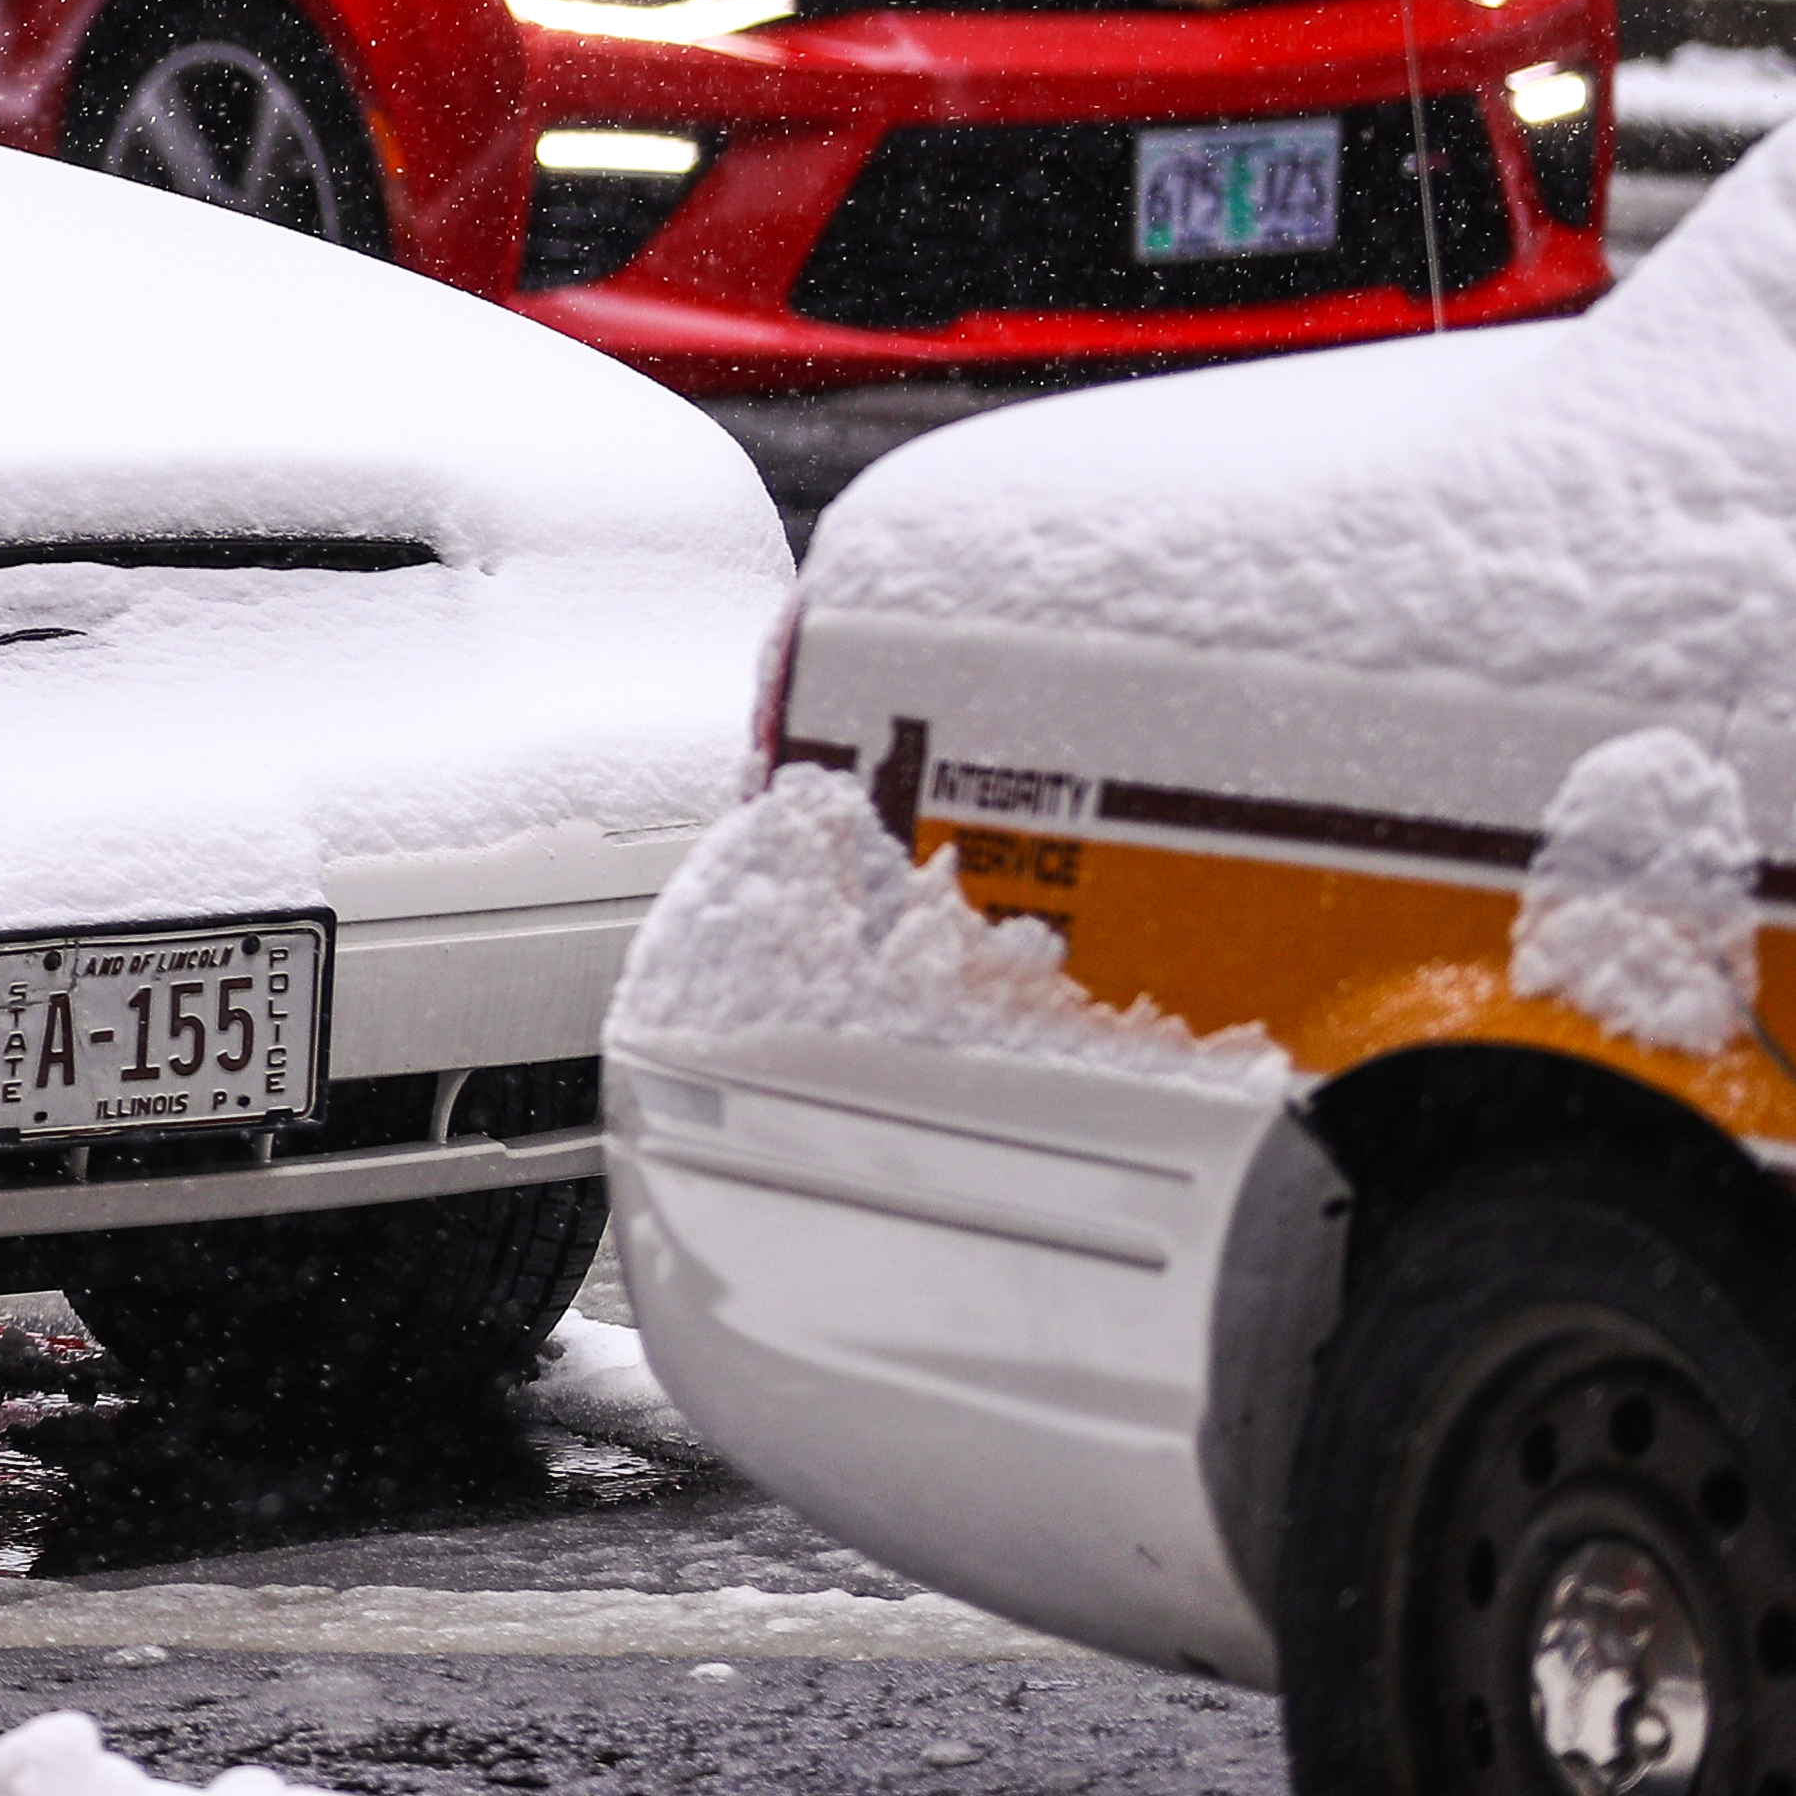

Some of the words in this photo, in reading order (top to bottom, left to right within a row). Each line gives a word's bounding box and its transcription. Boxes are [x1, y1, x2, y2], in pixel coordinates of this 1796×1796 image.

[931, 759, 1092, 822] INTEGRITY
[955, 826, 1080, 887] SERVICE
[71, 954, 125, 977] LAND
[129, 951, 156, 975] OF
[156, 944, 235, 974] LINCOLN
[2, 980, 29, 1102] STATE
[35, 975, 254, 1088] A-155
[265, 947, 289, 1093] POLICE
[95, 1090, 190, 1120] ILLINOIS
